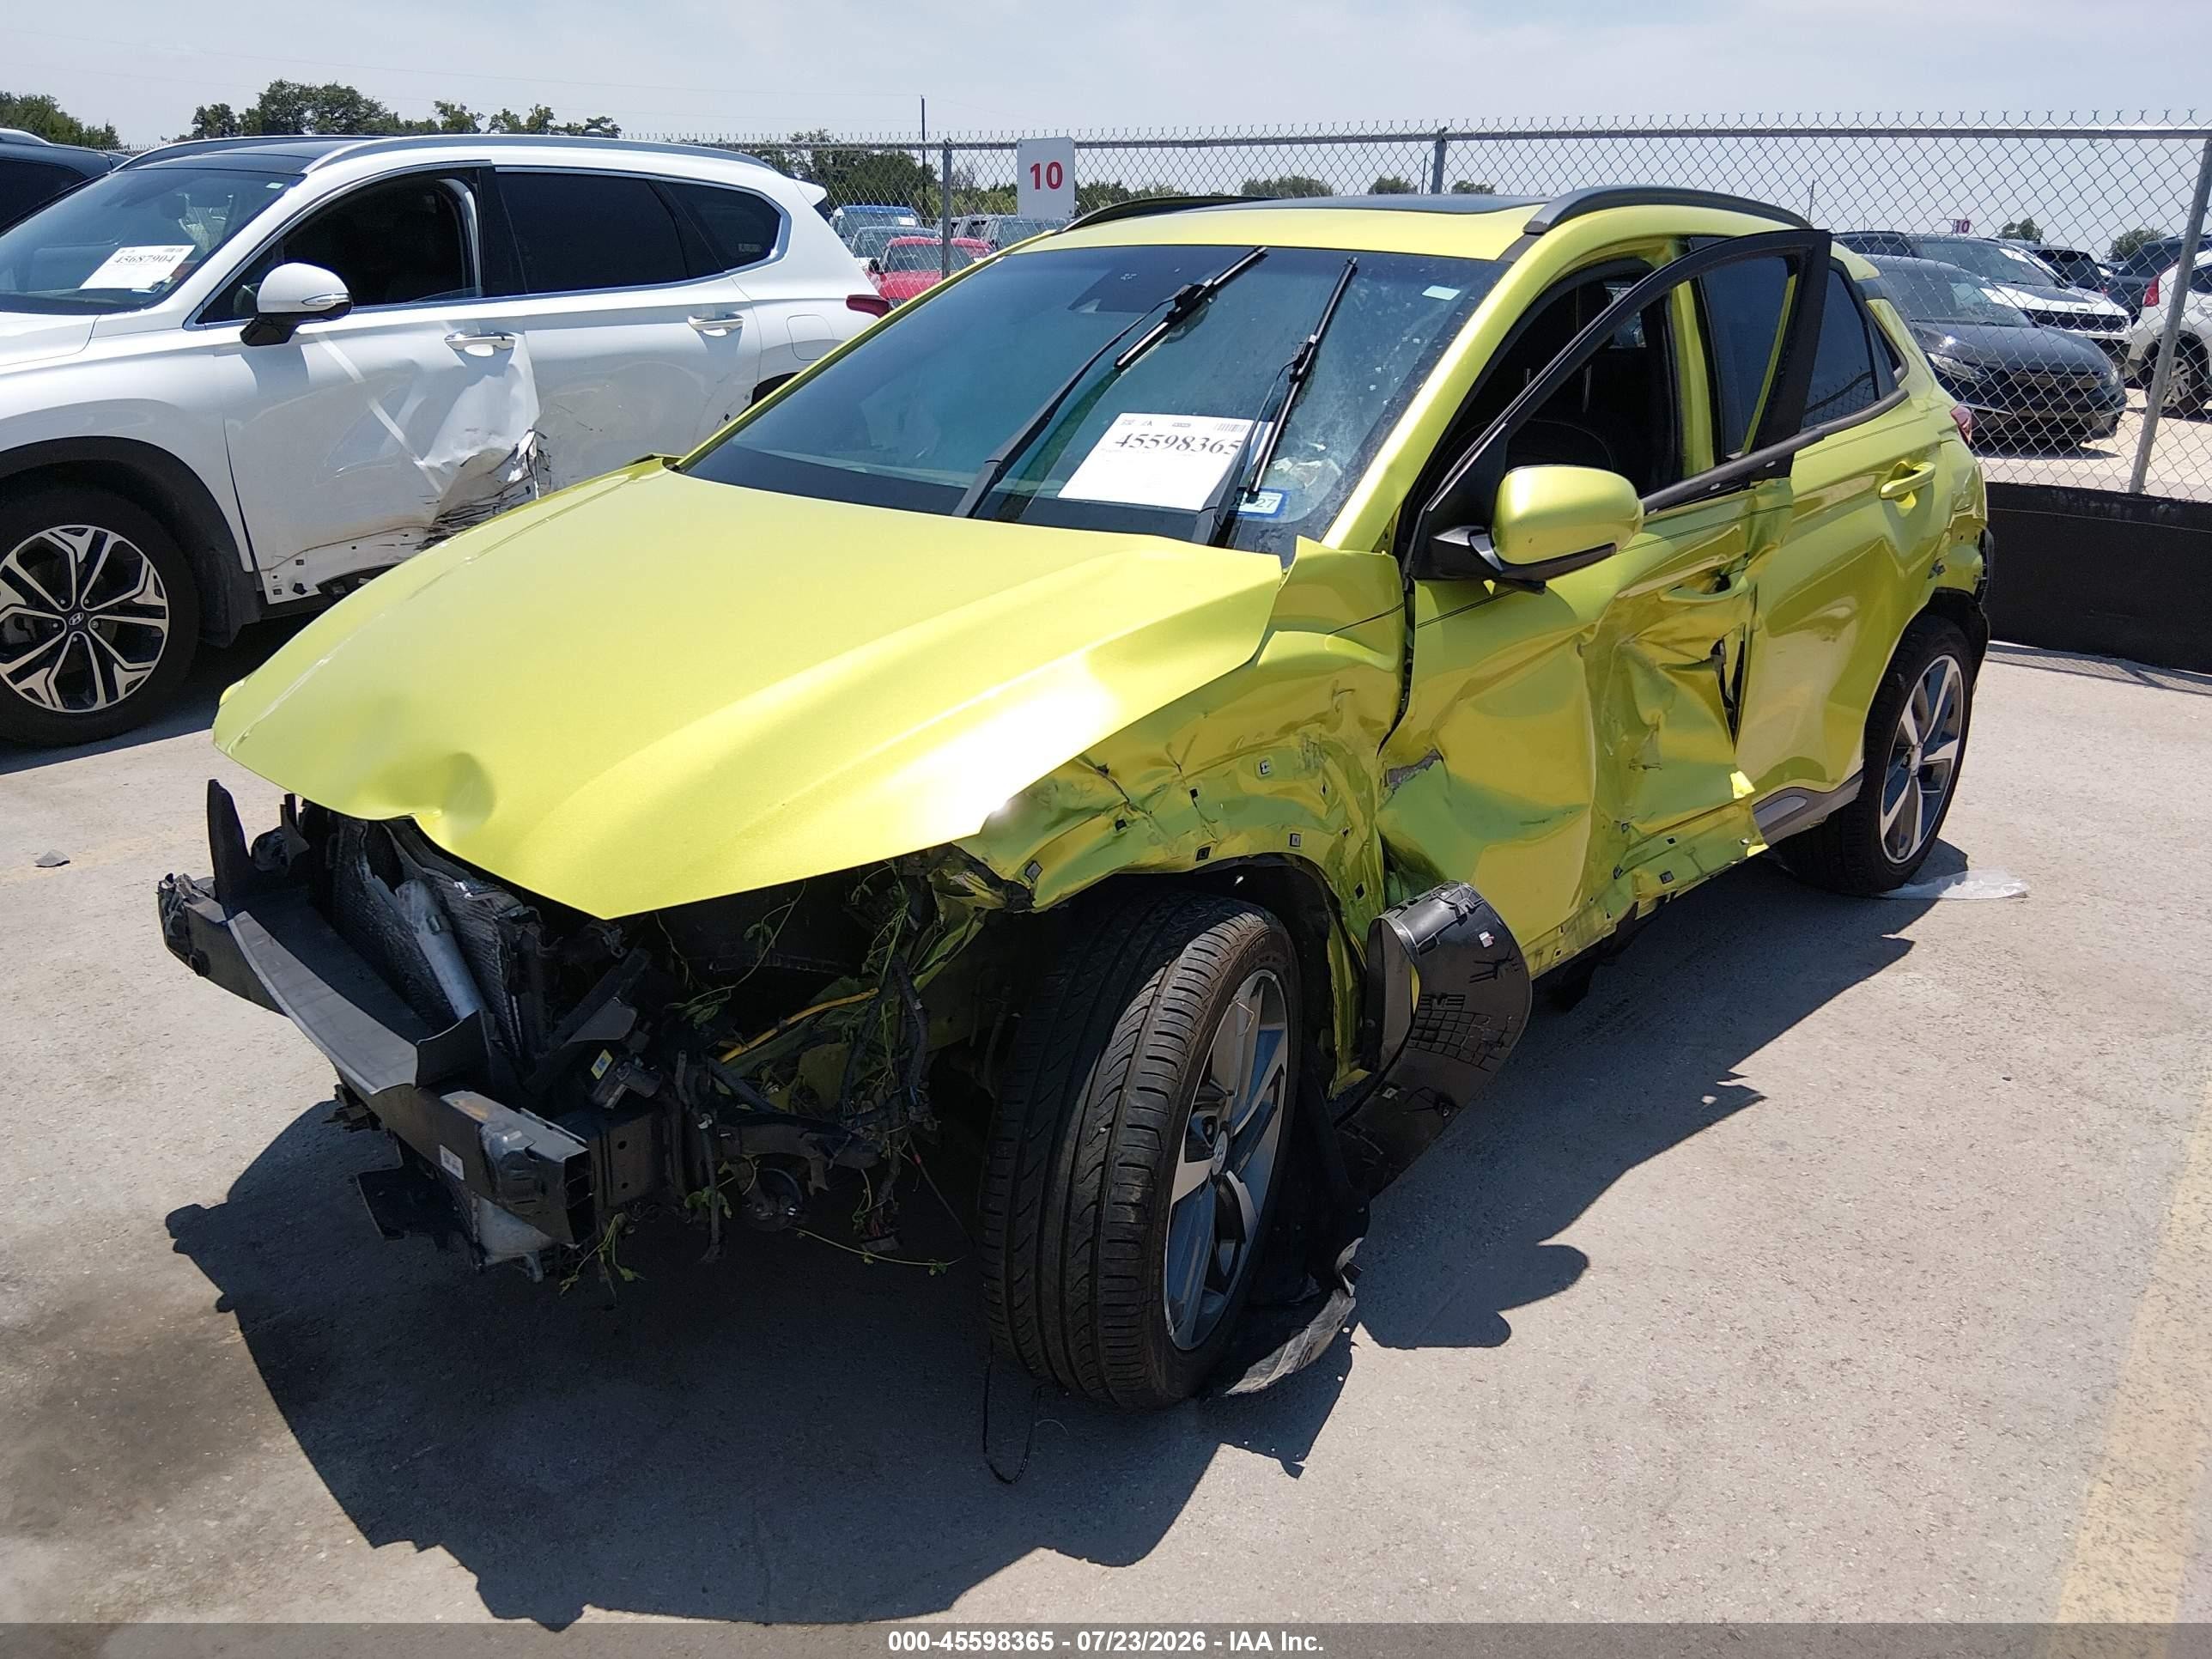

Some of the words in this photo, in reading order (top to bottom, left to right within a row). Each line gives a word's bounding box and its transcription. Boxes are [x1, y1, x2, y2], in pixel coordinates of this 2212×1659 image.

[1030, 161, 1063, 190] 10
[1954, 220, 1970, 233] 10
[1115, 433, 1243, 455] 45598365
[1255, 498, 1278, 508] 27
